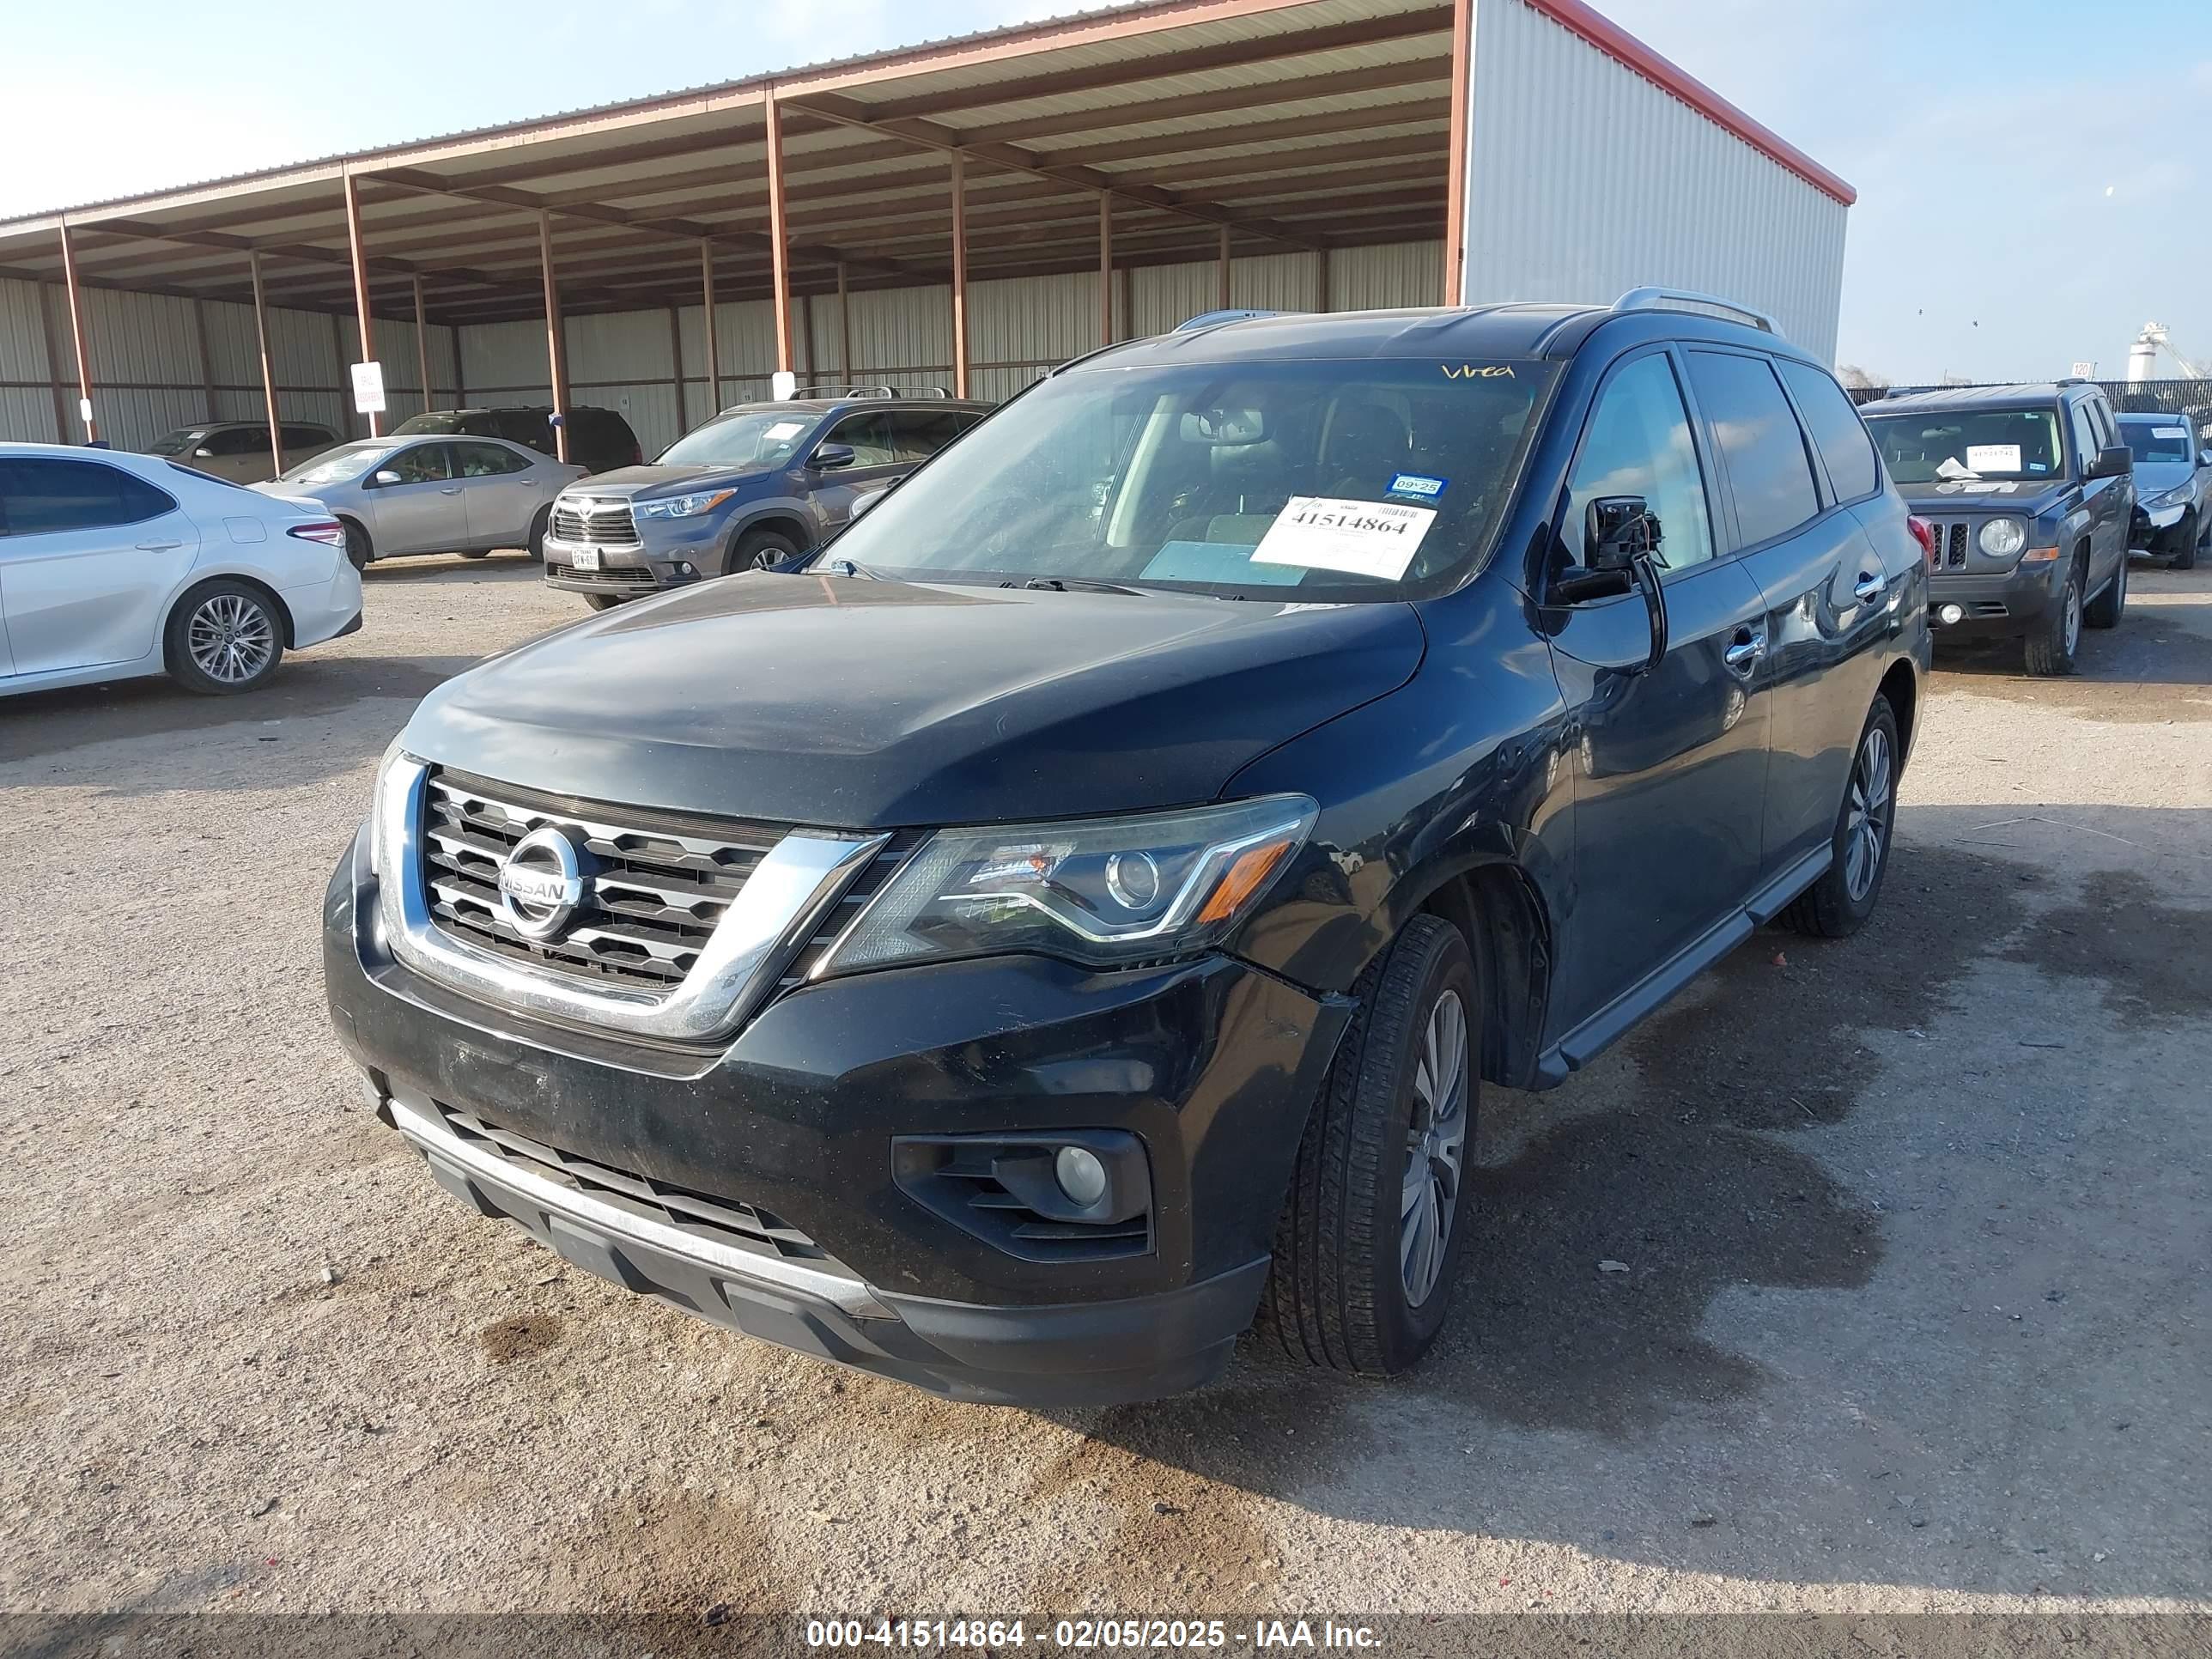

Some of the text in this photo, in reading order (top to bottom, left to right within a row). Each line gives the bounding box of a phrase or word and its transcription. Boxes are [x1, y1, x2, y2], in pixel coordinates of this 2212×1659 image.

[2075, 363, 2088, 375] 120
[1396, 480, 1438, 492] 09 25
[1291, 512, 1408, 534] 41514864
[500, 874, 564, 900] NISSAN
